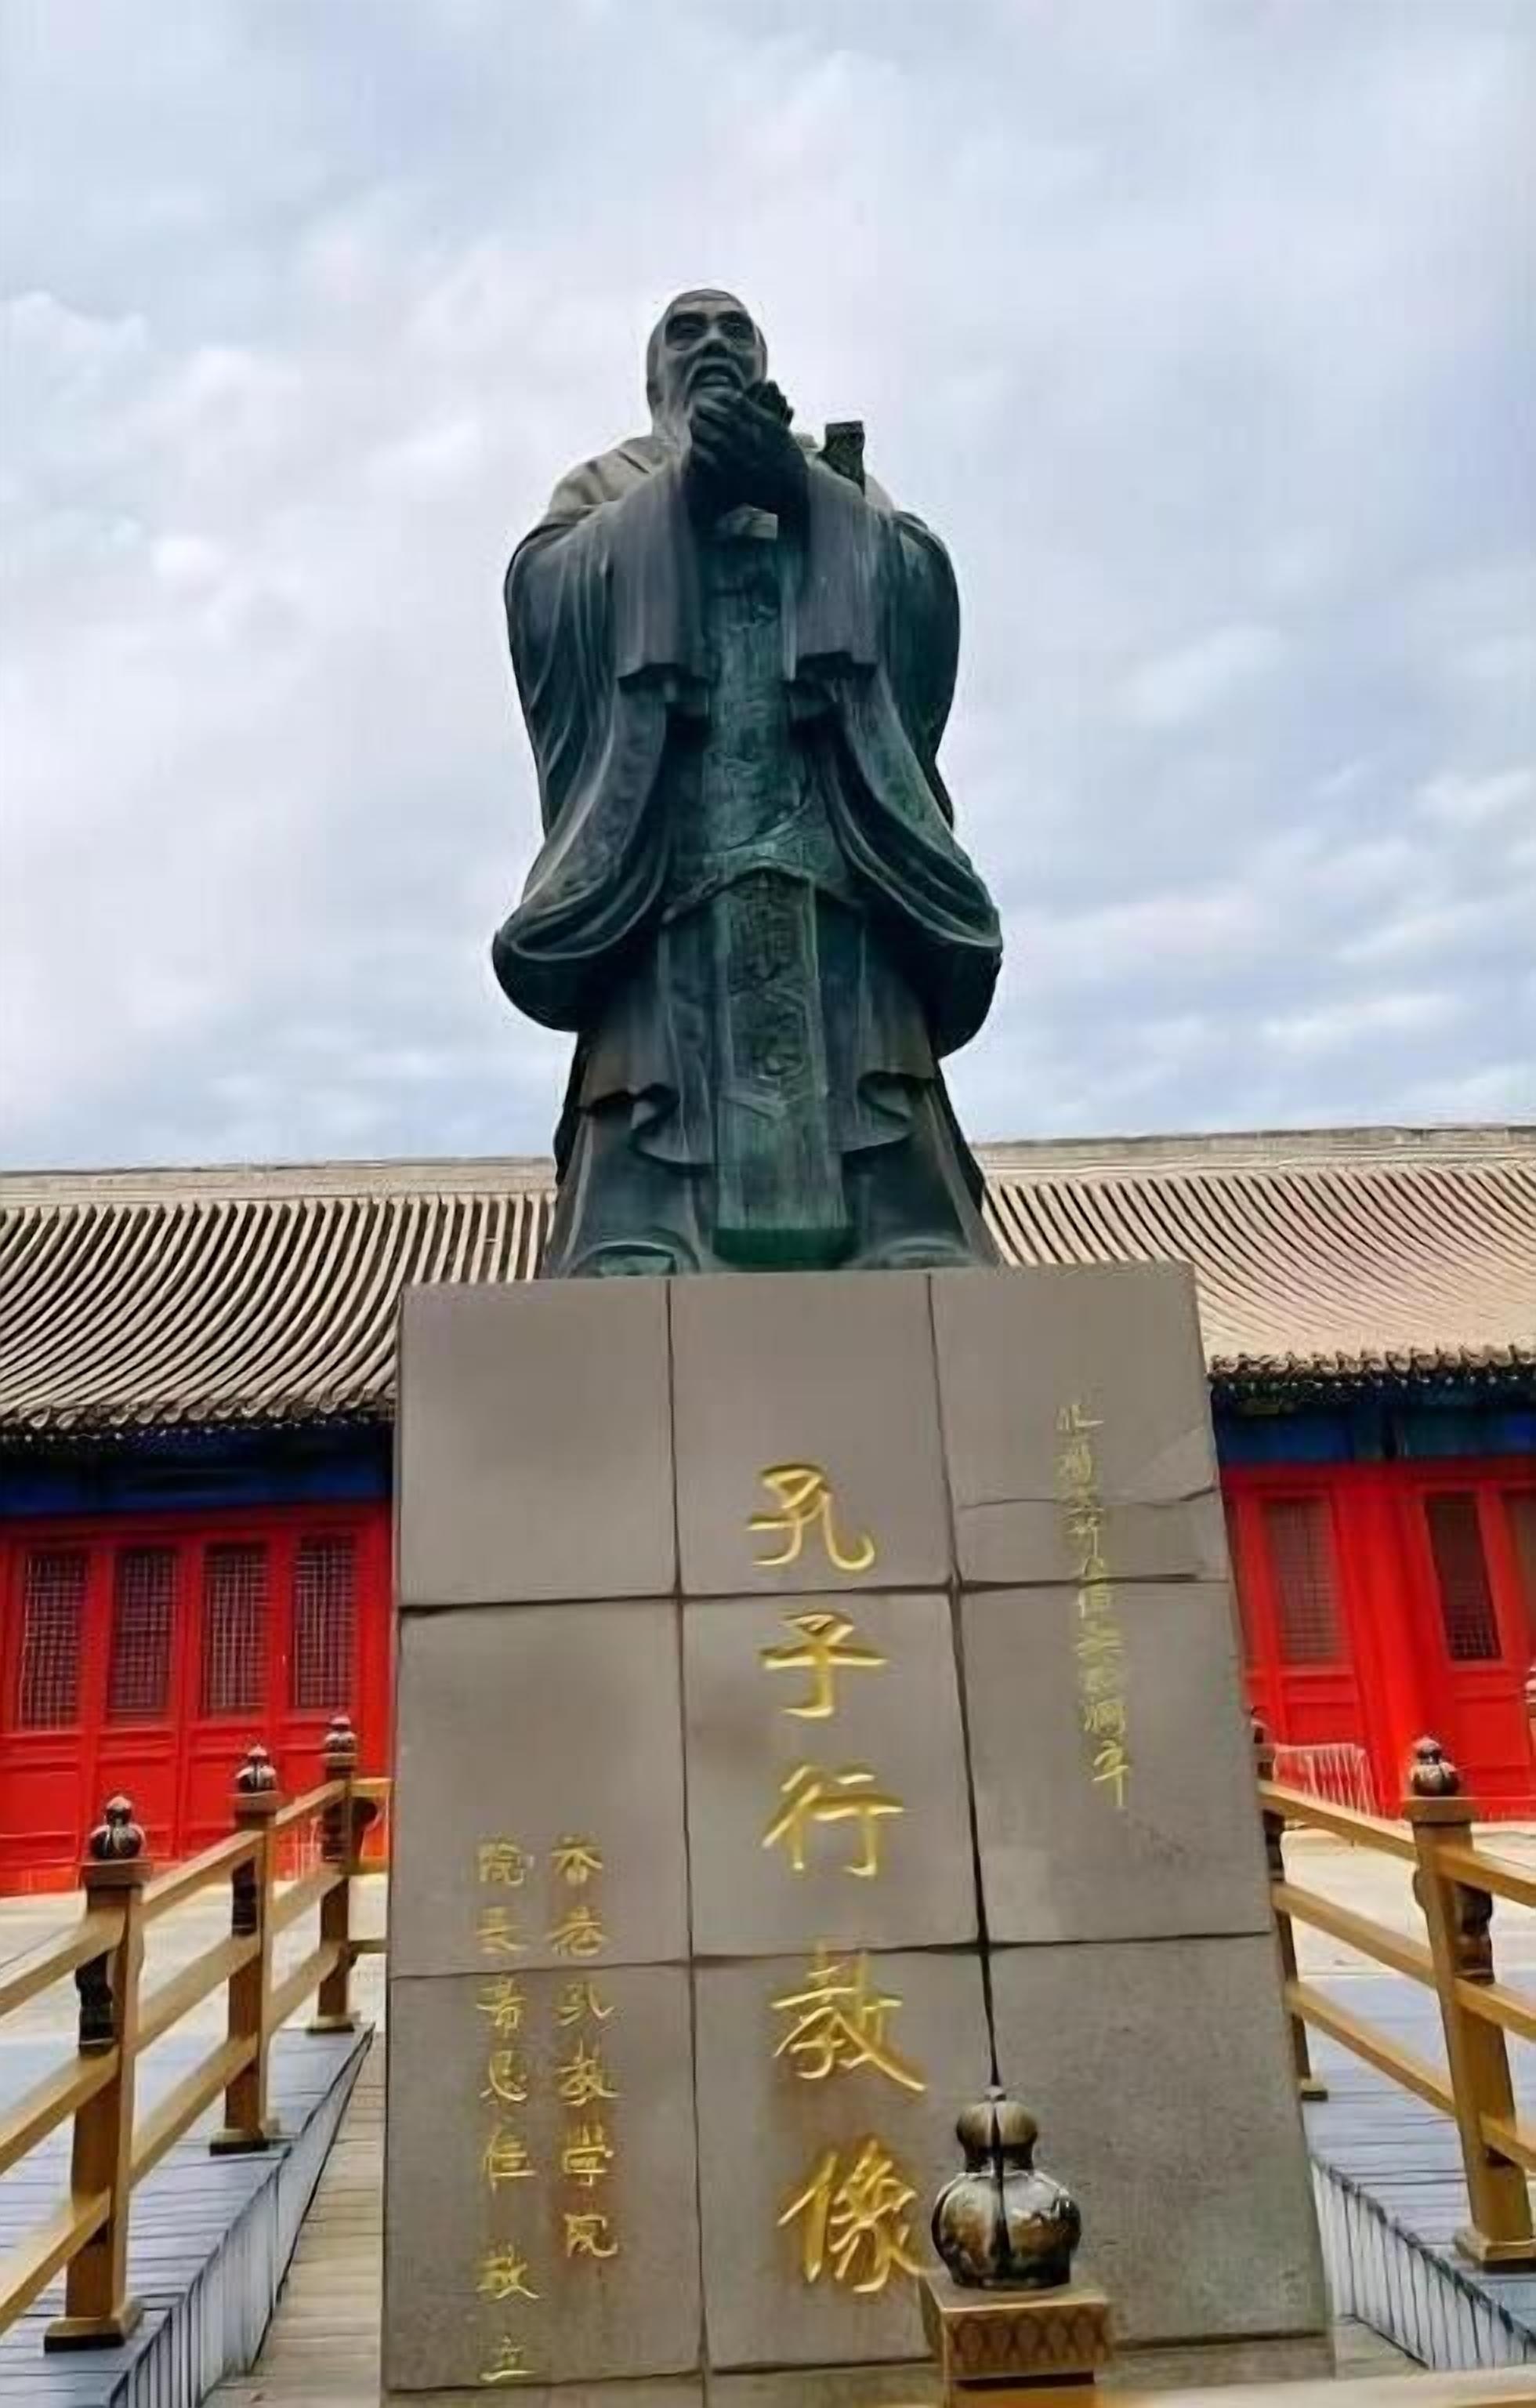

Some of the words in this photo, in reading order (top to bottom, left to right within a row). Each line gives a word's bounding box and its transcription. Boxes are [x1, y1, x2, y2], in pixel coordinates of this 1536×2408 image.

[745, 1464, 929, 2294] 孔子行教像
